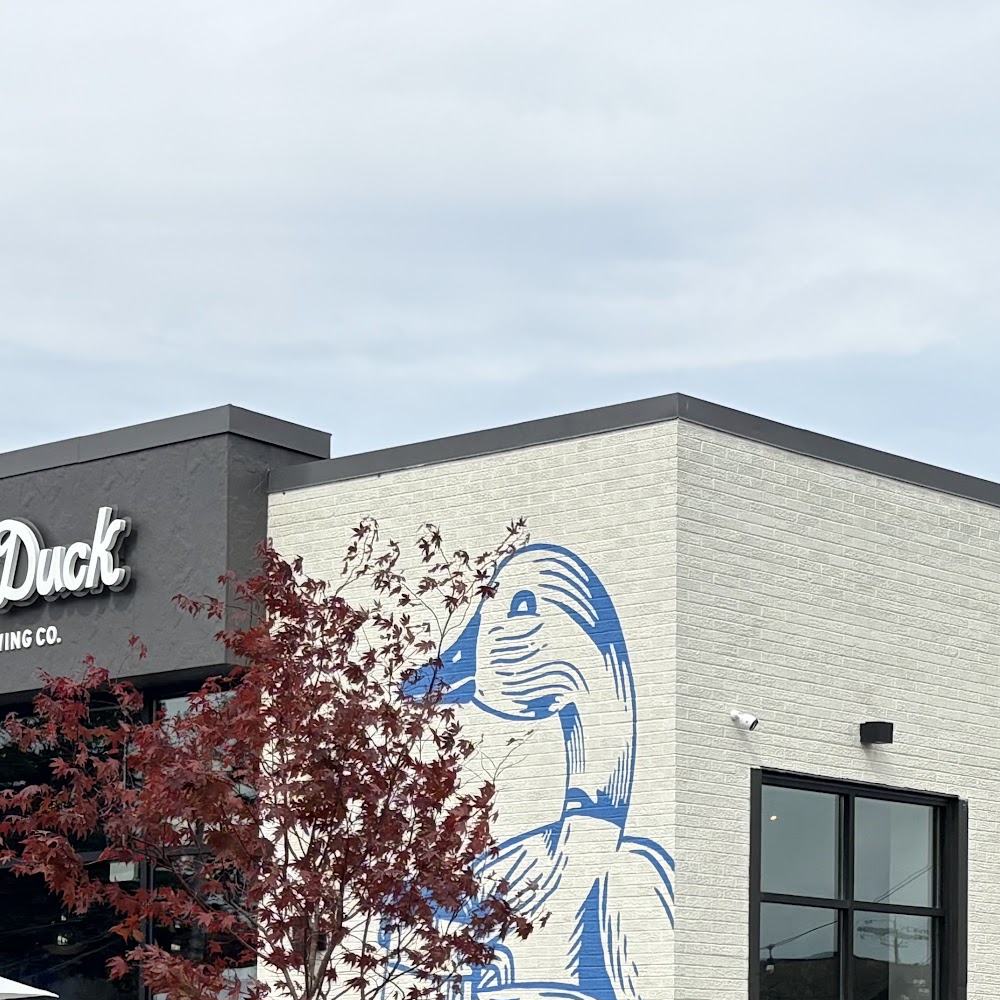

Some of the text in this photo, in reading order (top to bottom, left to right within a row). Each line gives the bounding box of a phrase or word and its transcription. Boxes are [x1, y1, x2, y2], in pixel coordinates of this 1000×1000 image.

[0, 506, 127, 608] Duck
[0, 625, 62, 652] ING CO.
